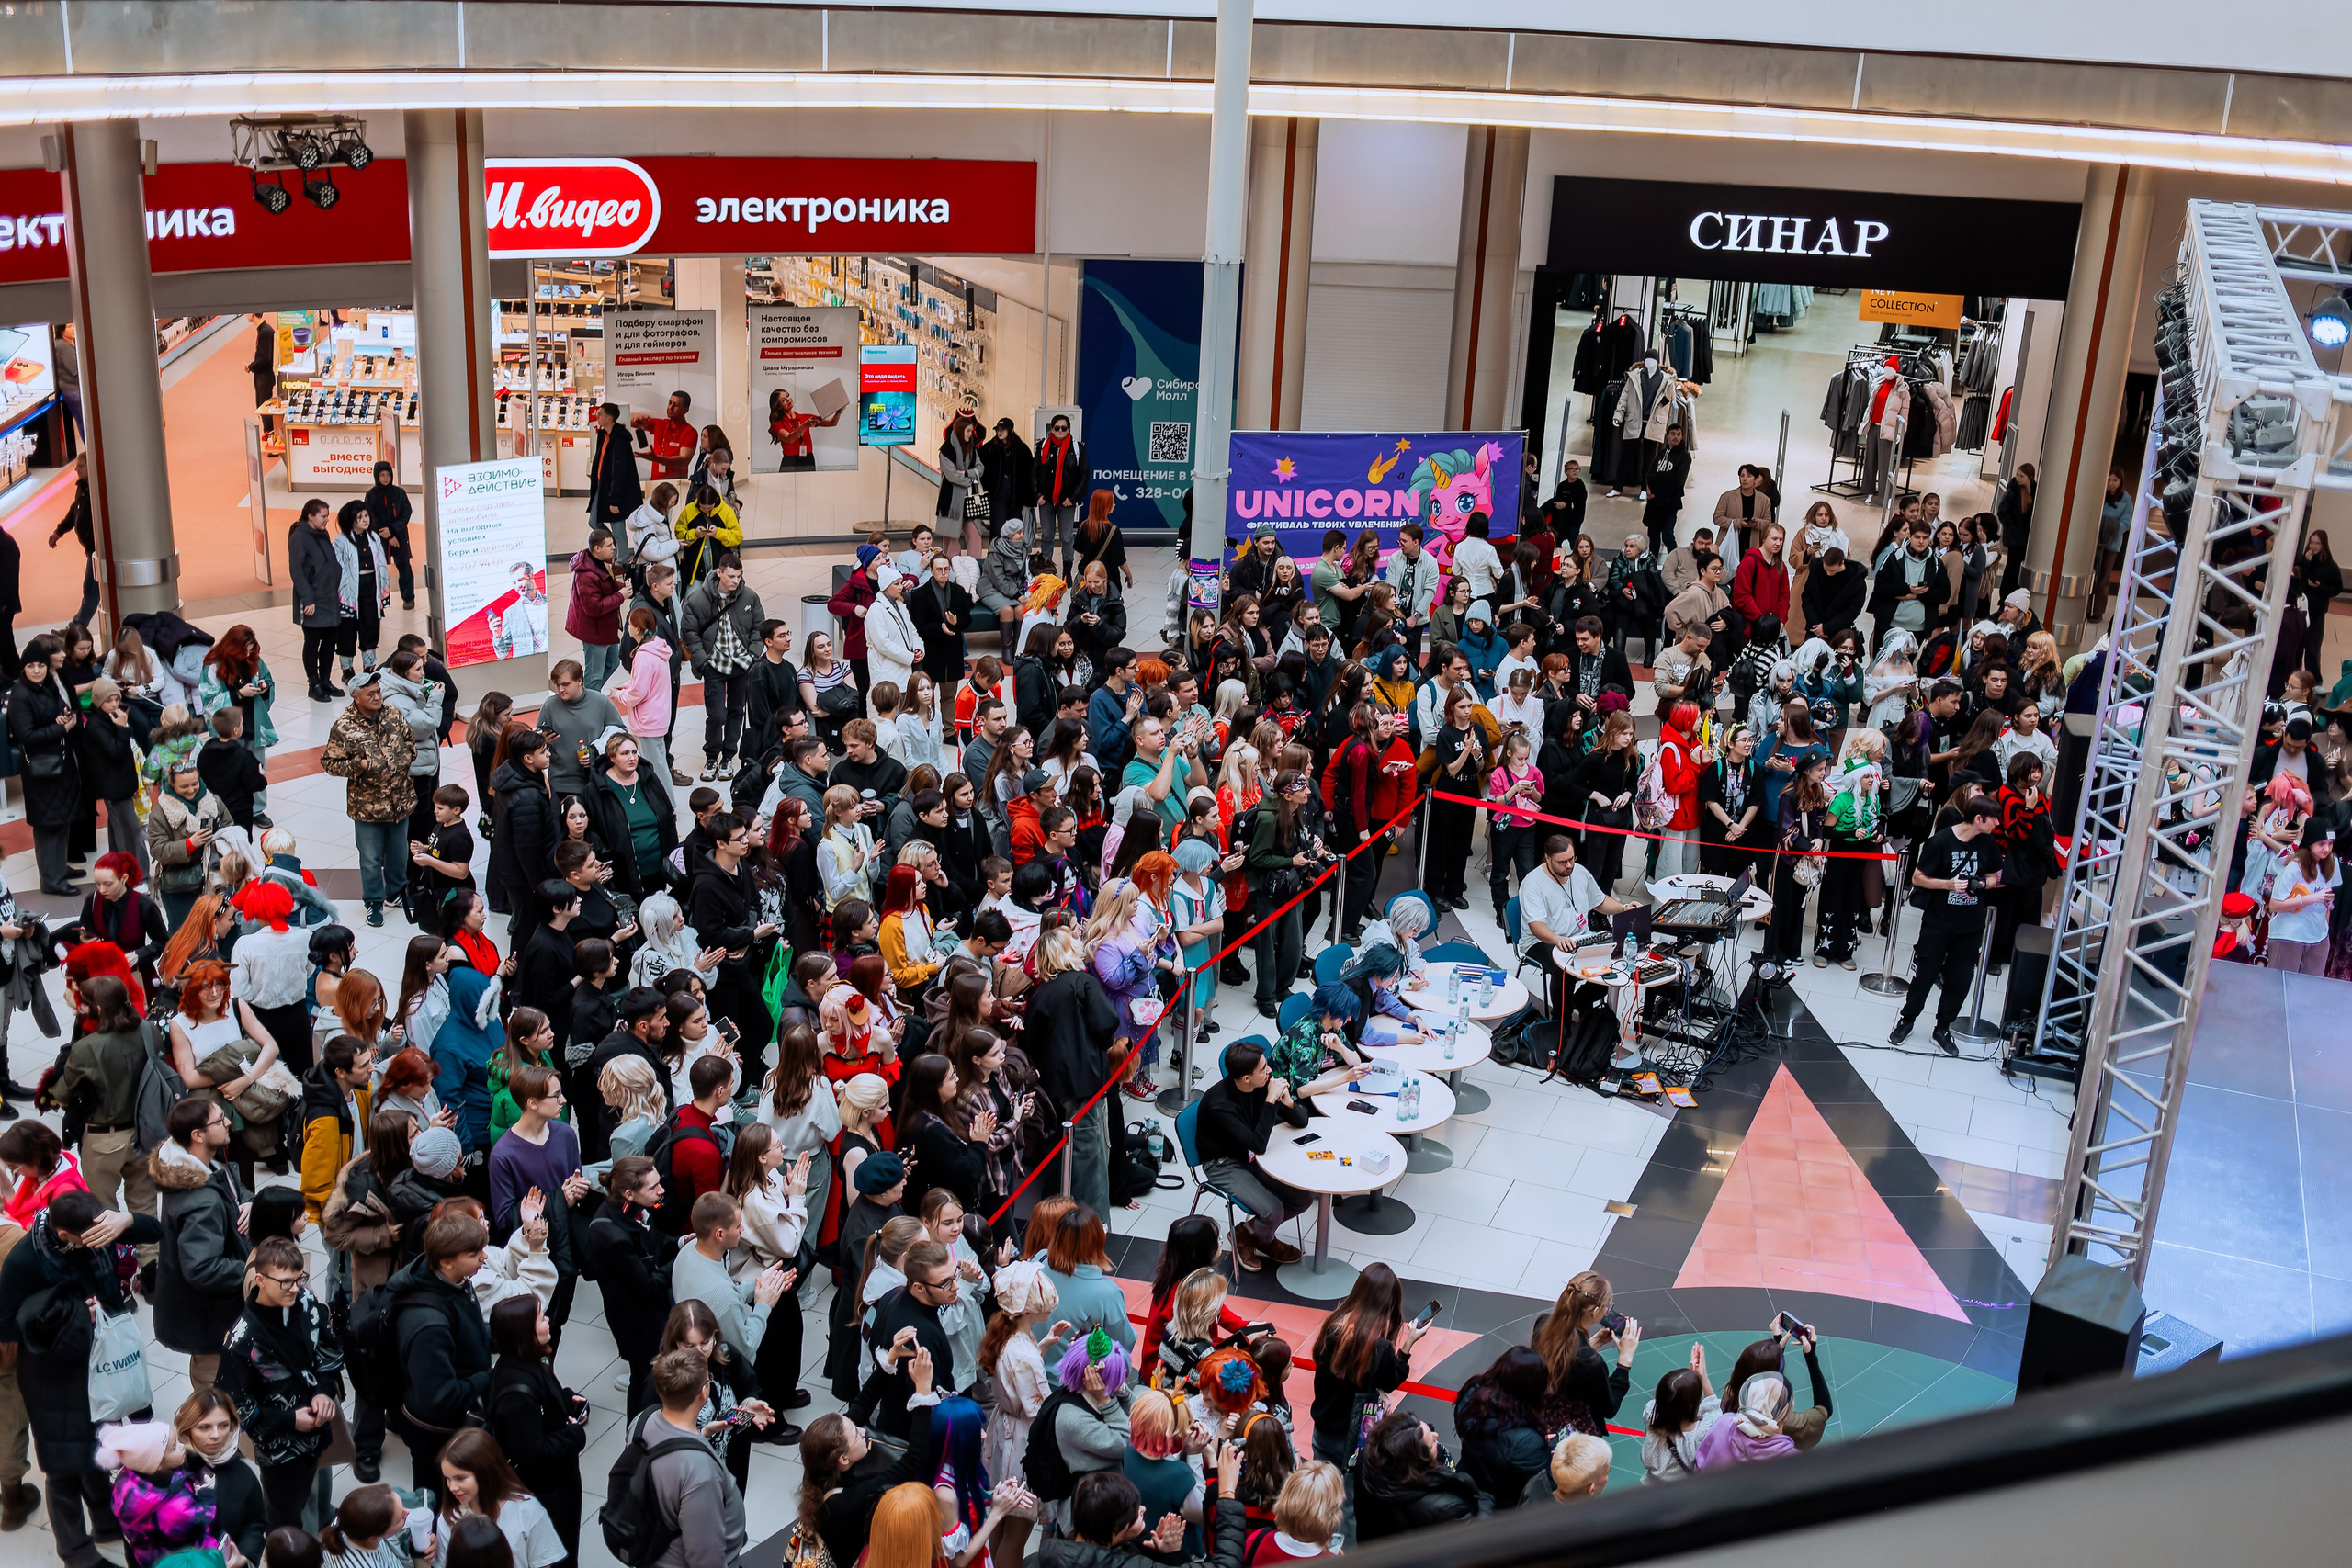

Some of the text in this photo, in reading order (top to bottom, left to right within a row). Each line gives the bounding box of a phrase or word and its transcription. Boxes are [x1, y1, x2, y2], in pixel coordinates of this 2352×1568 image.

[487, 182, 641, 237] М.видео
[695, 197, 950, 234] электроника
[1690, 211, 1890, 258] СИНАР
[1870, 299, 1935, 312] COLLECTION
[616, 317, 704, 328] Подберу смартфон
[761, 315, 811, 323] Настоящее
[761, 324, 820, 333] качество без
[624, 331, 640, 340] для
[643, 329, 701, 339] фотографов,
[761, 336, 828, 344] компромиссов
[624, 342, 640, 350] для
[643, 340, 687, 349] геймеров
[281, 380, 311, 390] realm
[1156, 378, 1200, 392] Сибирс
[1156, 391, 1188, 400] Молл
[313, 465, 373, 475] выгоднее
[1093, 469, 1175, 482] ПОМЕЩЕНИЕ
[1179, 471, 1187, 480] В
[1236, 488, 1420, 519] UNICORN
[460, 522, 503, 533] выгодных
[1246, 521, 1310, 529] ФЕСТИВАЛЬ
[1312, 521, 1345, 529] ТВОИХ
[447, 535, 487, 546] условиях
[448, 548, 471, 558] Бери
[1190, 561, 1219, 570] UNICORN
[96, 1362, 111, 1373] LC
